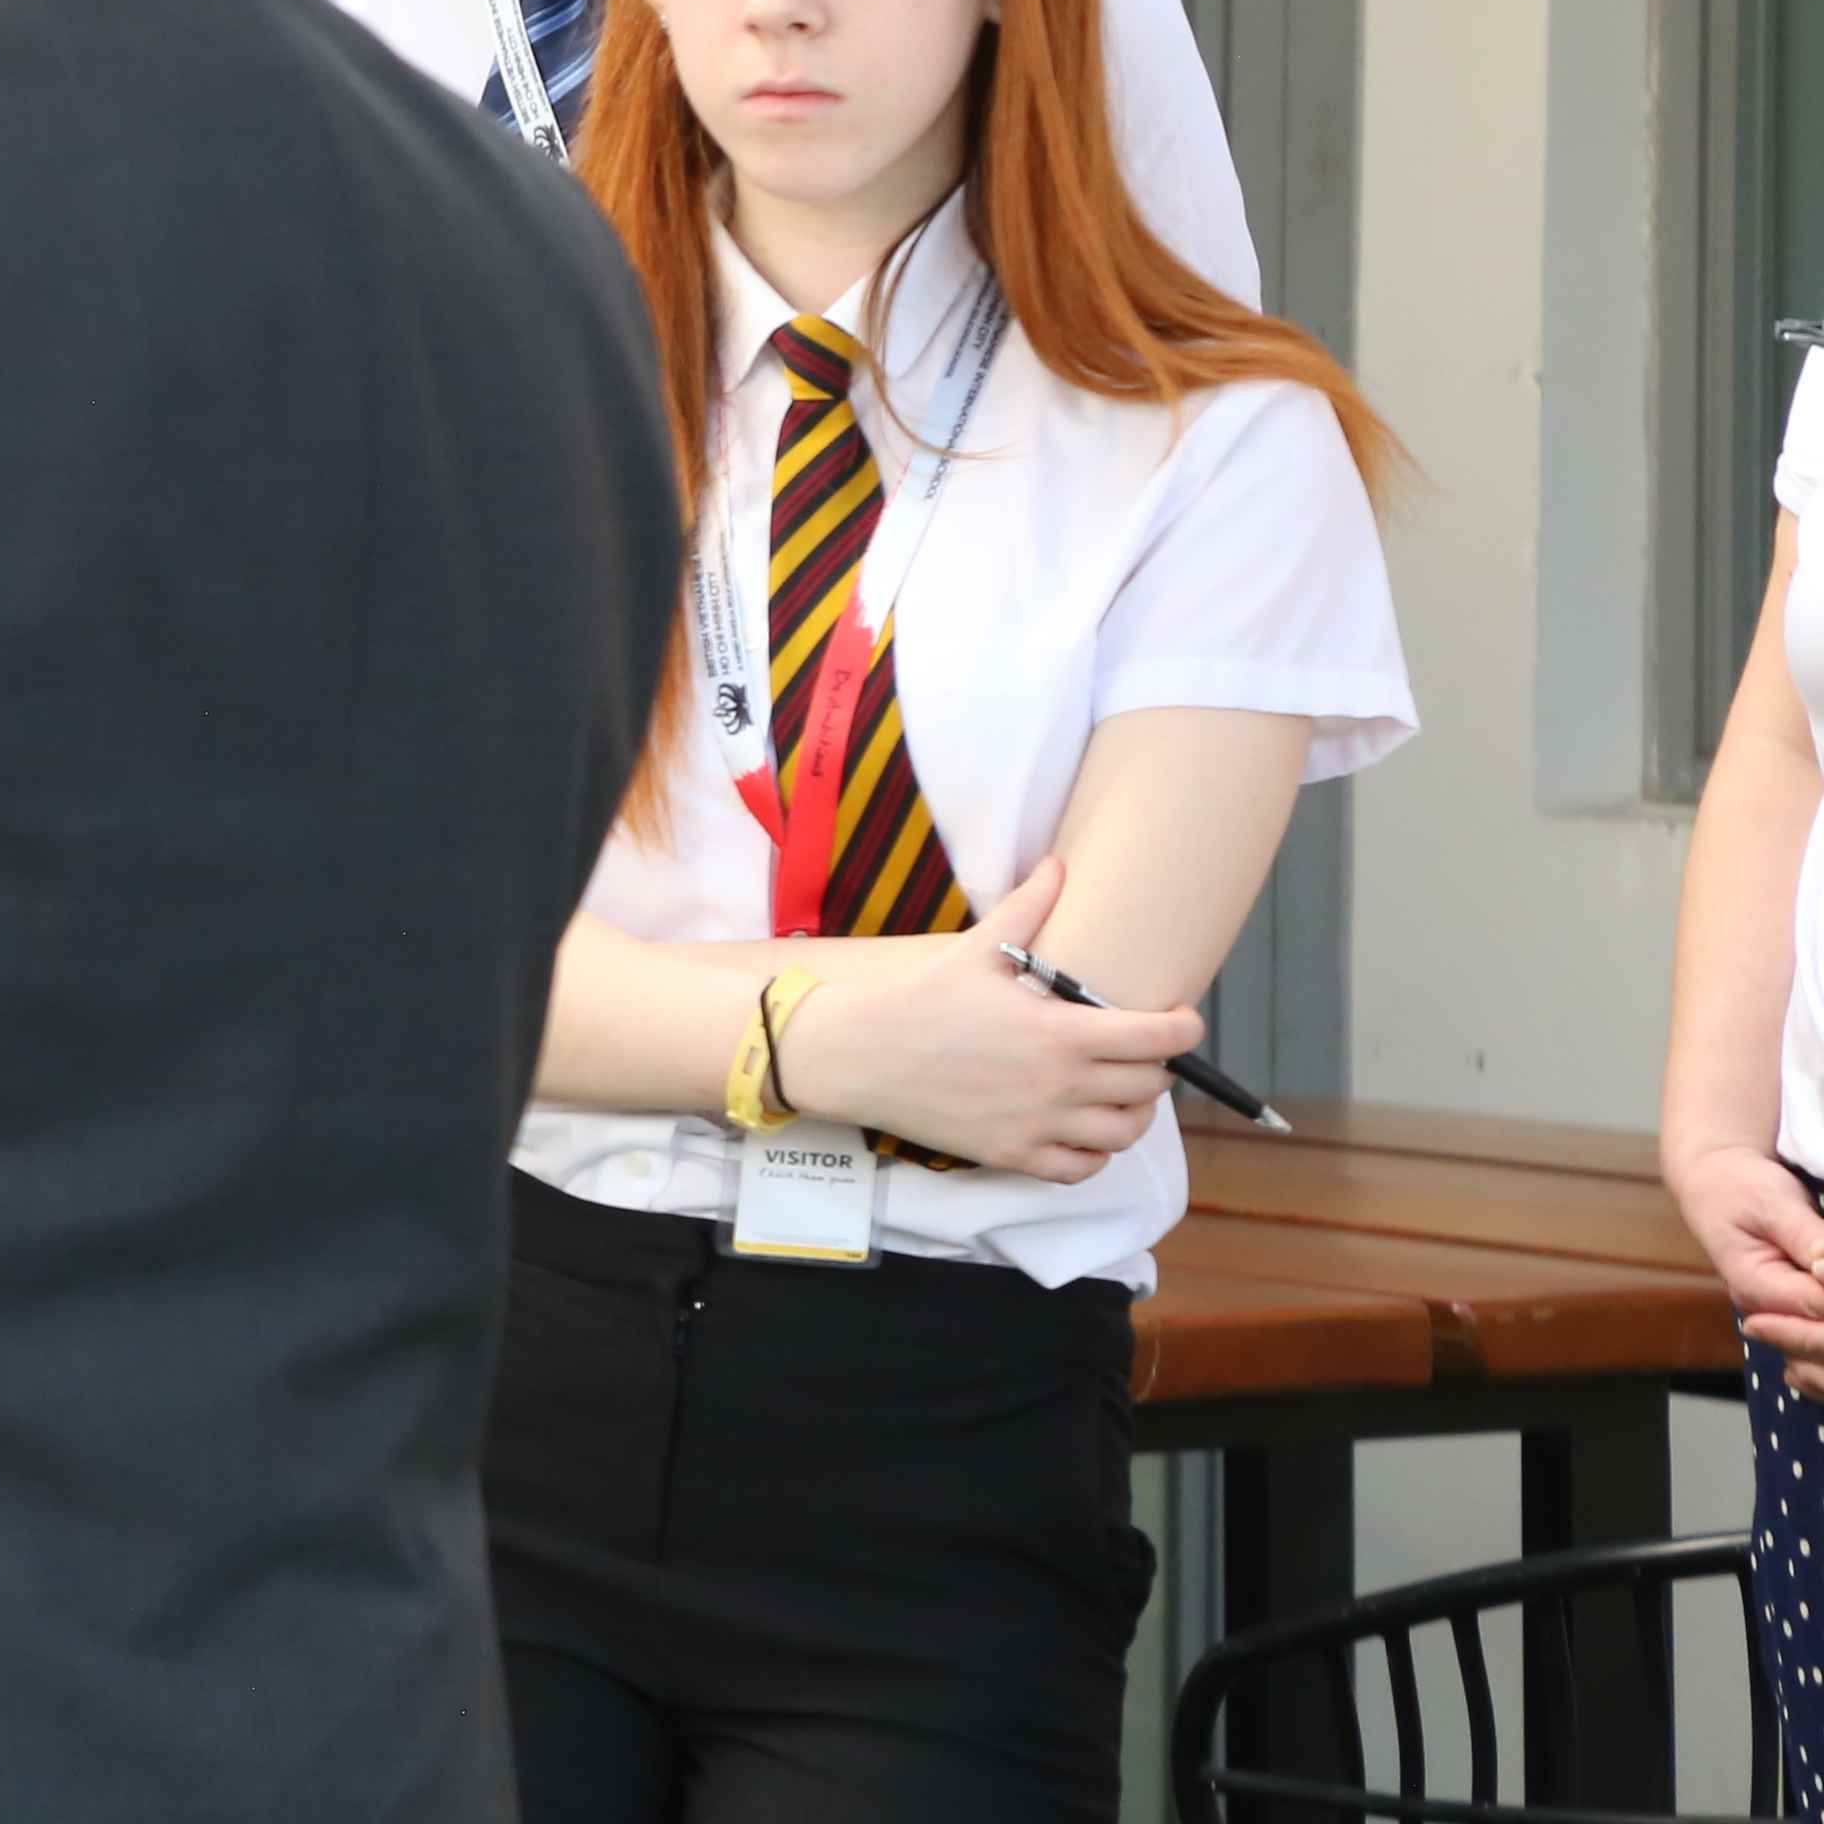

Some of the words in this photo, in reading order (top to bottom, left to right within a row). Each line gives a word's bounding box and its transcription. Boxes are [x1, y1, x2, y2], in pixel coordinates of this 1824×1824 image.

[706, 570, 719, 596] CITY
[700, 632, 718, 678] BRITISH
[719, 655, 730, 676] HO
[765, 1149, 853, 1169] VISITOR
